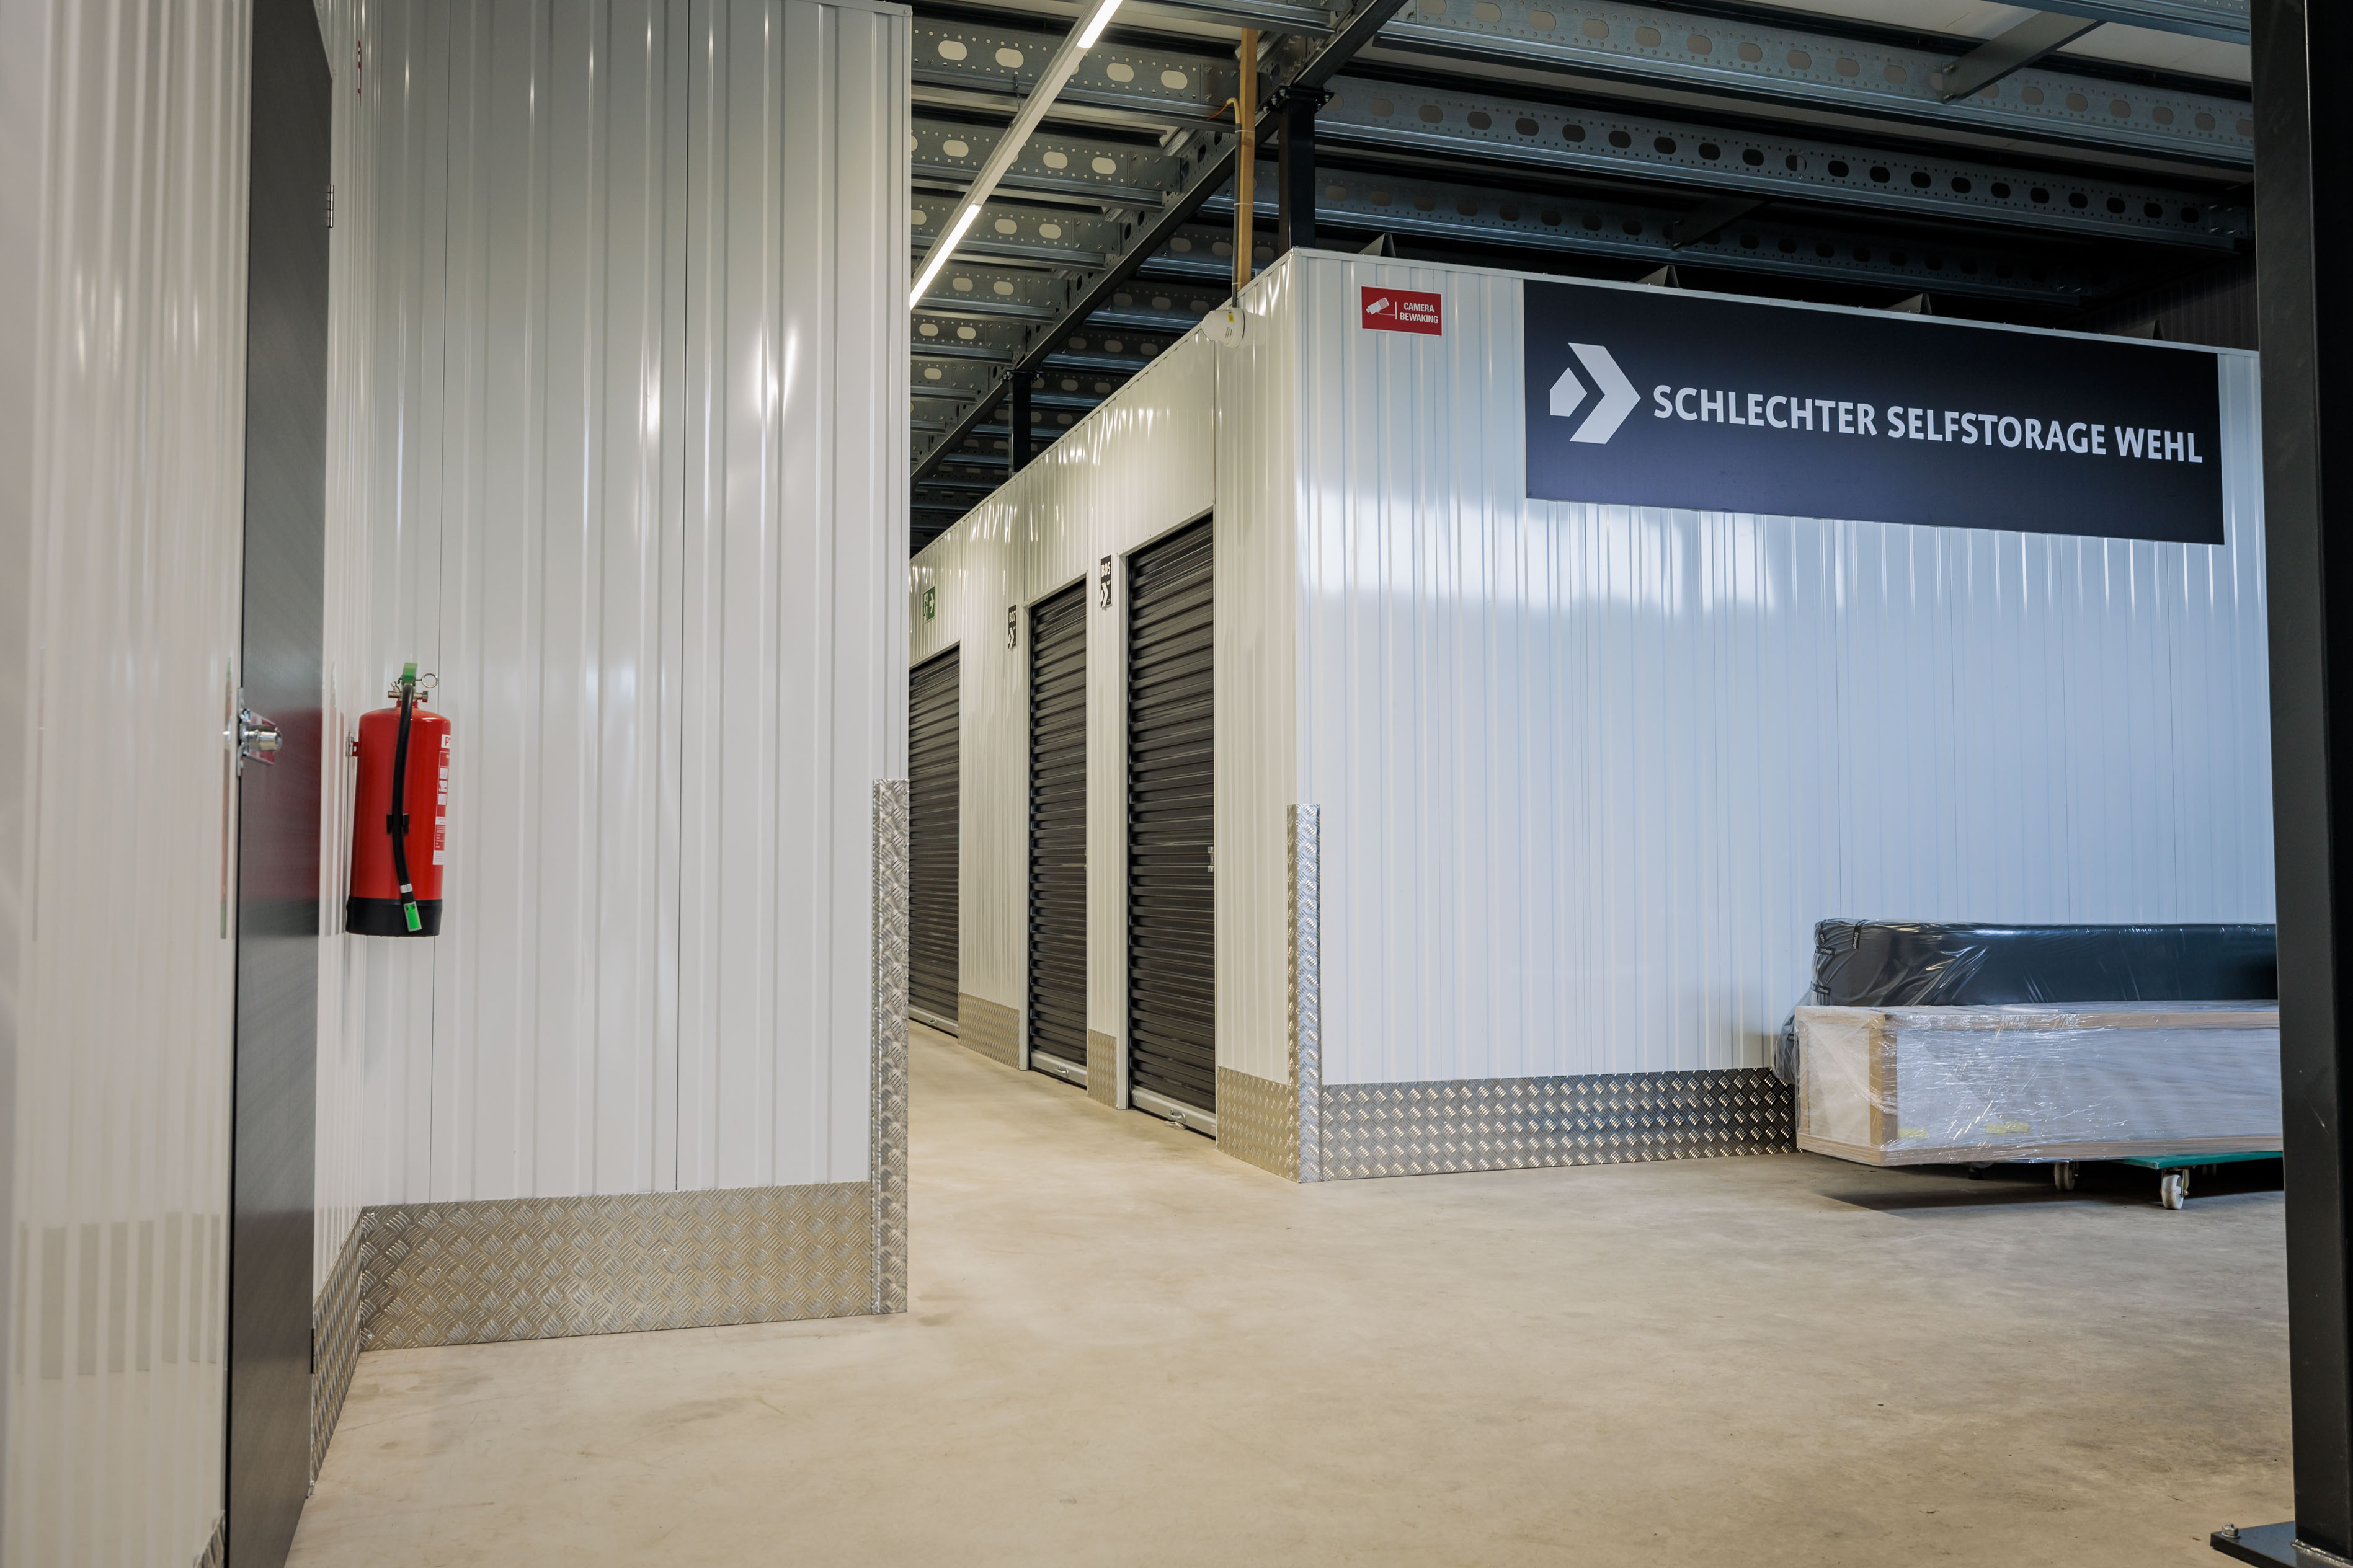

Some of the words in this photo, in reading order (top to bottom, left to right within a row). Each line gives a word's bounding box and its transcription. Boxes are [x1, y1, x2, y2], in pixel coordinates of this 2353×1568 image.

[1403, 302, 1434, 312] CAMERA
[1400, 312, 1438, 323] BEWAKING
[1653, 384, 1878, 436] SCHLECHTER
[1887, 405, 2106, 455] SELFSTORAGE
[2114, 426, 2202, 463] WEHL
[1101, 561, 1111, 577] B05
